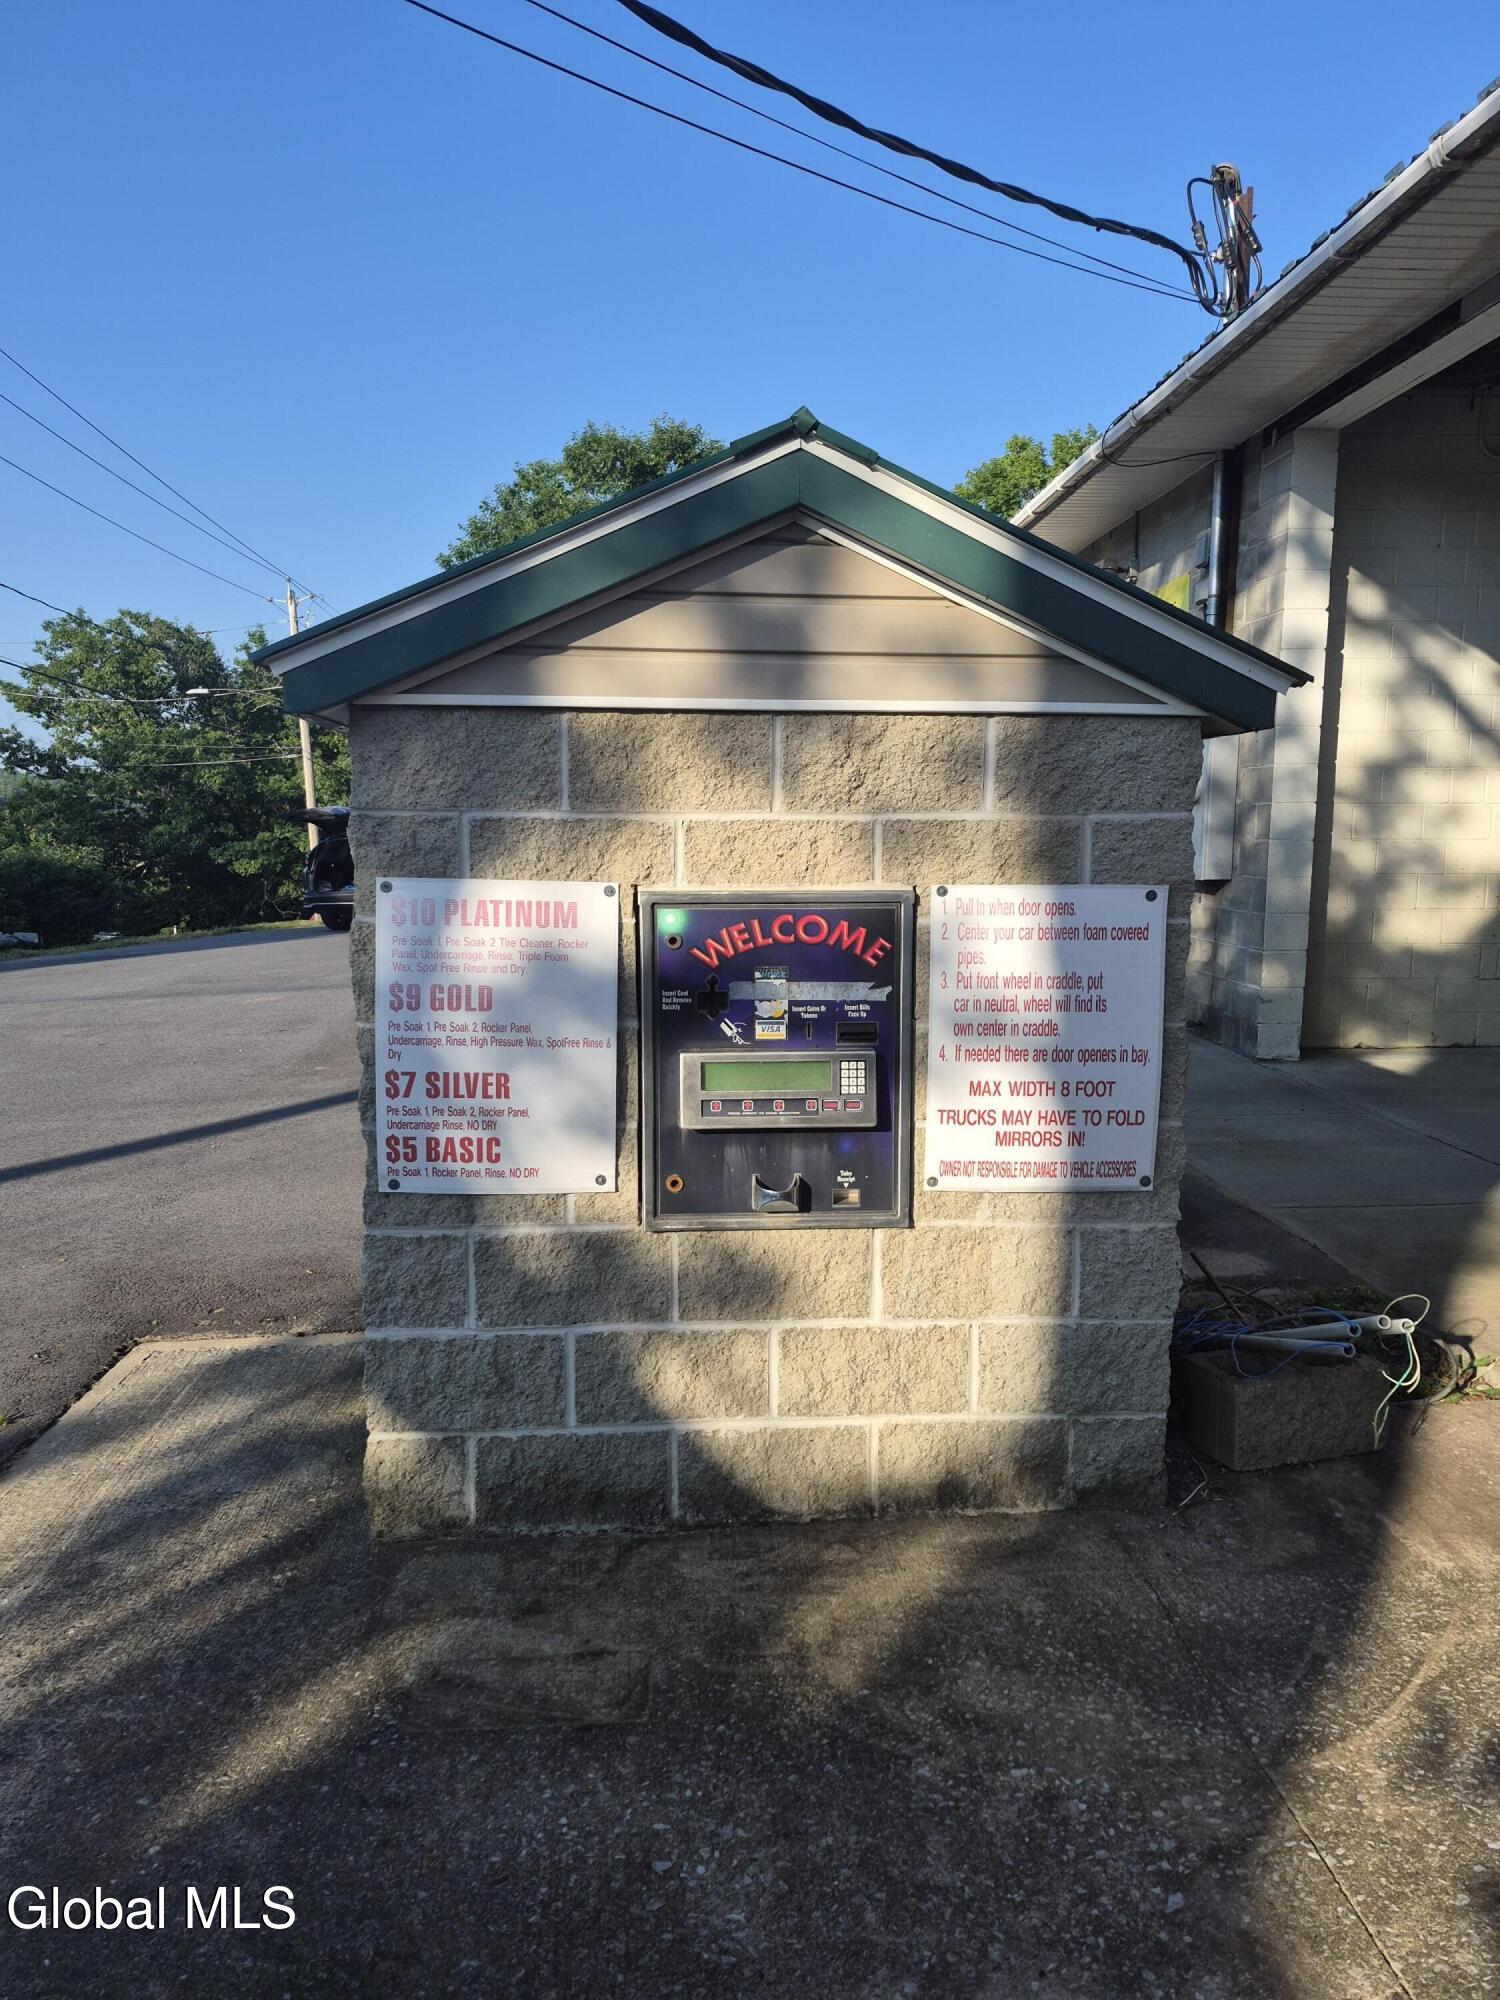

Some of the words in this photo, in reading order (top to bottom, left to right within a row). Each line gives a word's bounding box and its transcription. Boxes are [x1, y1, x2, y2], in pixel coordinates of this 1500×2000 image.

[391, 897, 436, 928] $10
[443, 899, 578, 929] PLATINUM
[956, 898, 974, 916] Pull
[989, 898, 1015, 916] when
[1018, 898, 1041, 916] door
[1045, 901, 1077, 920] opens.
[690, 913, 893, 969] WELCOME
[941, 922, 950, 940] 2.
[957, 922, 990, 941] Center
[994, 927, 1015, 944] your
[1019, 927, 1035, 941] car
[1038, 922, 1079, 941] between
[1083, 922, 1107, 941] foam
[1111, 923, 1149, 941] covered
[392, 936, 407, 946] Pre
[410, 936, 433, 946] Soak
[446, 937, 460, 947] Pre
[464, 936, 486, 947] Soak
[500, 937, 517, 948] Tire
[559, 939, 589, 949] Rocker
[544, 951, 569, 962] Foam
[957, 947, 986, 969] pipes.
[416, 962, 438, 974] Spot
[441, 963, 460, 973] Free
[464, 963, 487, 973] Rinse
[490, 964, 508, 974] and
[941, 971, 949, 989] 3.
[956, 971, 973, 989] Put
[976, 971, 999, 989] front
[1002, 971, 1031, 989] wheel
[1034, 971, 1043, 989] in
[1046, 971, 1085, 992] craddle,
[1087, 971, 1103, 993] put
[388, 981, 422, 1013] $9
[429, 984, 494, 1012] GOLD
[954, 998, 970, 1012] car
[973, 995, 981, 1012] in
[984, 995, 1020, 1014] neutral,
[1023, 995, 1052, 1012] wheel
[1055, 995, 1071, 1013] will
[1075, 995, 1093, 1013] find
[1095, 995, 1107, 1013] its
[388, 1020, 401, 1031] Pre
[404, 1021, 423, 1032] Soak
[434, 1021, 447, 1032] Pre
[450, 1021, 469, 1032] Soak
[481, 1022, 508, 1033] Rocker
[761, 1025, 781, 1033] VISA
[953, 1022, 974, 1037] own
[977, 1019, 1008, 1037] center
[1011, 1019, 1019, 1037] in
[1022, 1019, 1060, 1037] craddle.
[470, 1036, 488, 1049] High
[490, 1036, 523, 1048] Pressure
[582, 1038, 604, 1048] Rinse
[939, 1044, 948, 1062] 4.
[955, 1044, 962, 1062] If
[965, 1044, 1001, 1062] needed
[1005, 1044, 1029, 1062] there
[1032, 1048, 1048, 1063] are
[1051, 1045, 1075, 1063] door
[1078, 1048, 1117, 1066] openers
[1120, 1044, 1128, 1063] in
[1131, 1045, 1150, 1066] bay.
[385, 1069, 417, 1100] $7
[425, 1071, 511, 1099] SILVER
[969, 1080, 1002, 1097] MAX
[1008, 1081, 1056, 1097] WIDTH
[1061, 1081, 1070, 1097] 8
[1075, 1081, 1116, 1097] FOOT
[386, 1106, 400, 1117] Pre
[402, 1106, 421, 1117] Soak
[432, 1106, 445, 1117] Pre
[448, 1106, 467, 1117] Soak
[479, 1107, 505, 1117] Rocker
[508, 1107, 530, 1119] Panel,
[937, 1109, 996, 1126] TRUCKS
[1001, 1110, 1032, 1126] MAY
[1038, 1110, 1076, 1126] HAVE
[1082, 1110, 1102, 1126] TO
[1107, 1110, 1145, 1126] FOLD
[467, 1120, 480, 1131] NO
[482, 1120, 498, 1131] DRY
[995, 1131, 1062, 1147] MIRRORS
[1068, 1131, 1086, 1147] IN!
[385, 1134, 418, 1164] $5
[426, 1136, 501, 1164] BASIC
[387, 1166, 400, 1177] Pre
[403, 1166, 422, 1177] Soak
[432, 1167, 458, 1178] Rocker
[510, 1168, 522, 1178] NO
[524, 1168, 540, 1178] DRY
[939, 1160, 961, 1177] OWNER
[963, 1160, 976, 1178] NOT
[977, 1160, 1018, 1178] RESPONSIBLE
[1019, 1161, 1032, 1179] FOR
[1033, 1161, 1058, 1178] DAMAGE
[1060, 1161, 1068, 1178] TO
[1070, 1161, 1095, 1178] VEHICLE
[1096, 1160, 1137, 1178] ACCESSORIES
